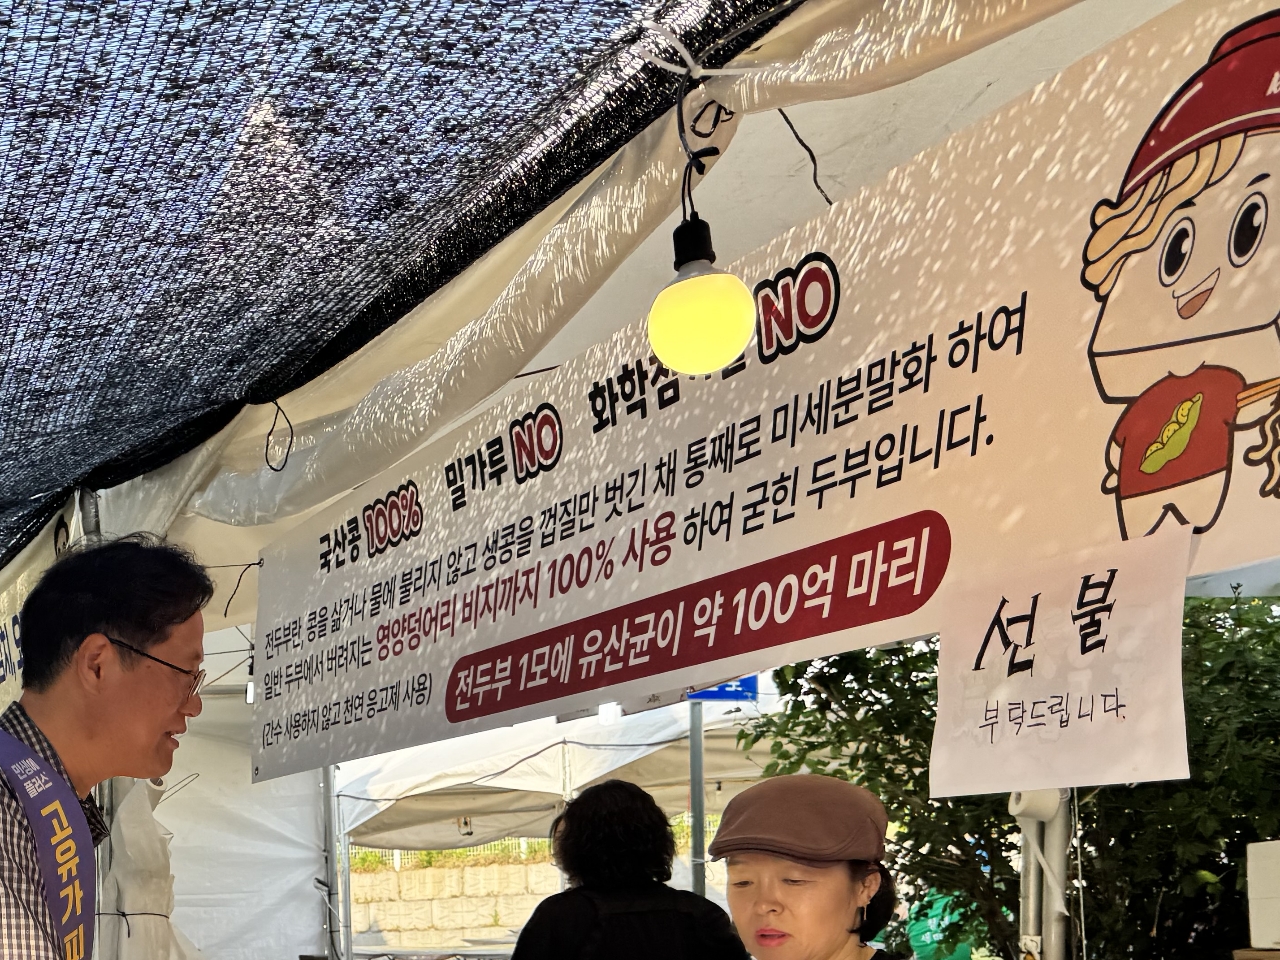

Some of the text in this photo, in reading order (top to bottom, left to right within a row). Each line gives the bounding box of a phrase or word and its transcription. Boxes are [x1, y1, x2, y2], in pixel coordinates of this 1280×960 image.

[264, 290, 1028, 661] 전두부란, 콩을 삶거나 물에 불리지 않고 생콩을 껍질만 벗긴 채 통째로 미세분말화 하여
[319, 515, 362, 574] 국산콩
[363, 480, 423, 558] 100%
[445, 435, 508, 512] 밀가루
[509, 403, 563, 484] NO
[754, 251, 840, 365] NO
[263, 394, 995, 701] 일반 두부에서 버려지는 영양덩어리 비지까지 100% 사용 하여 굳힌 두부입니다.
[454, 527, 932, 711] 전두부 1모에 유산균이 약 100억 마리
[11, 758, 41, 780] 민생에
[261, 672, 433, 750] (간수 사용하지 않고 천연 응고제 사용)
[40, 799, 84, 926] 고유가
